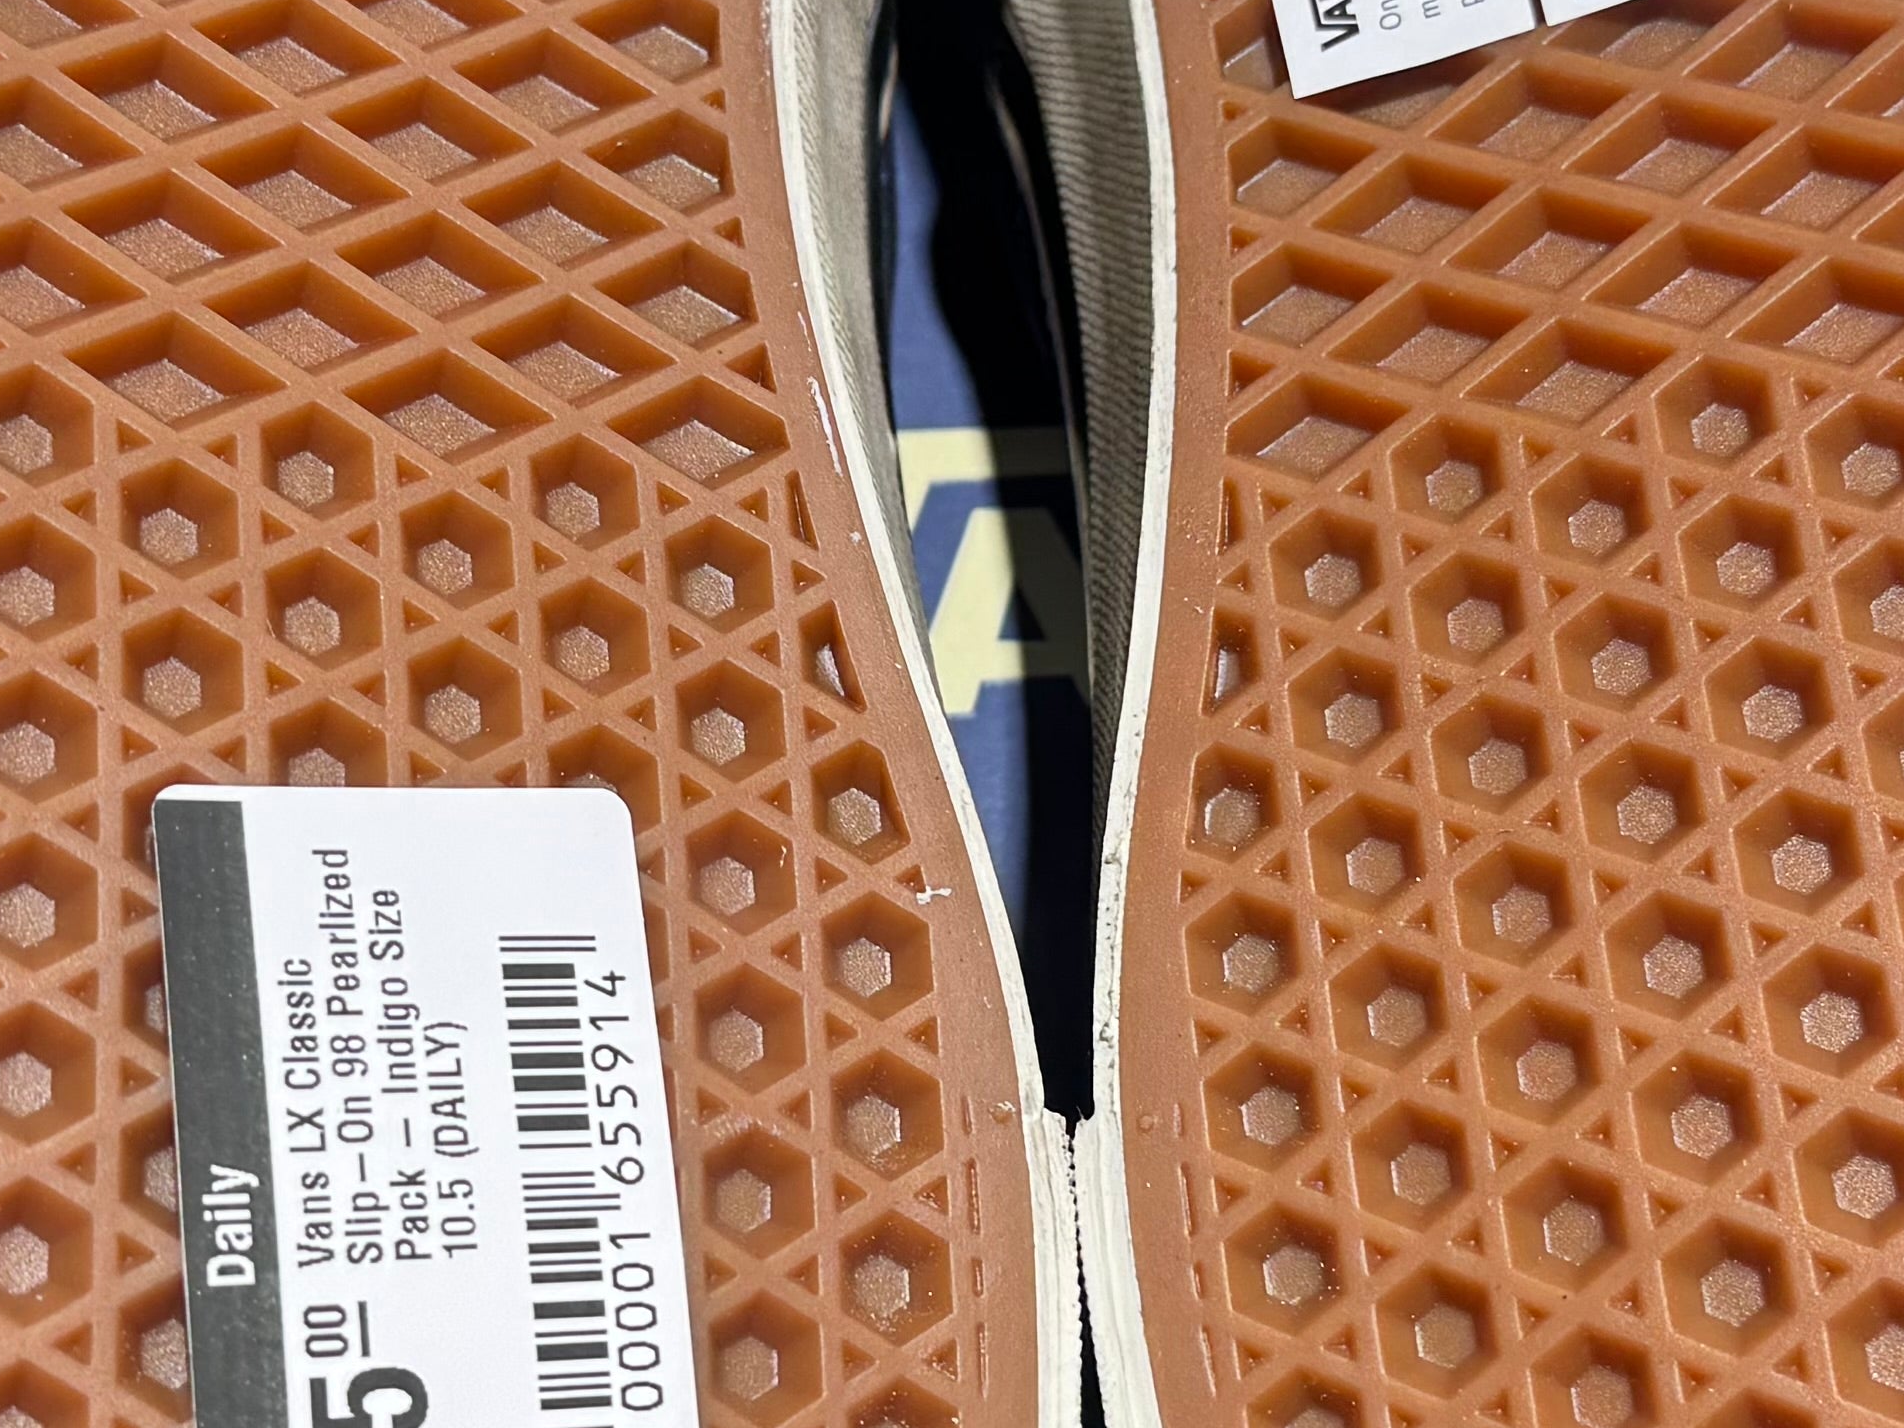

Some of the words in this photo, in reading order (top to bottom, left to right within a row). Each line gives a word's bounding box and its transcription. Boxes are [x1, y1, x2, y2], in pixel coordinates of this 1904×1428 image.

[310, 848, 364, 1016] Pearlized
[366, 889, 405, 961] Size
[276, 958, 321, 1090] Classic
[328, 1033, 369, 1078] 98
[375, 976, 421, 1094] Indigo
[587, 971, 644, 1184] 655914
[285, 1106, 327, 1153] LX
[421, 1020, 479, 1158] (DAILY)
[200, 1163, 260, 1288] Daily
[295, 1170, 335, 1269] Vans
[388, 1167, 433, 1261] Pack
[435, 1177, 478, 1259] 10.5
